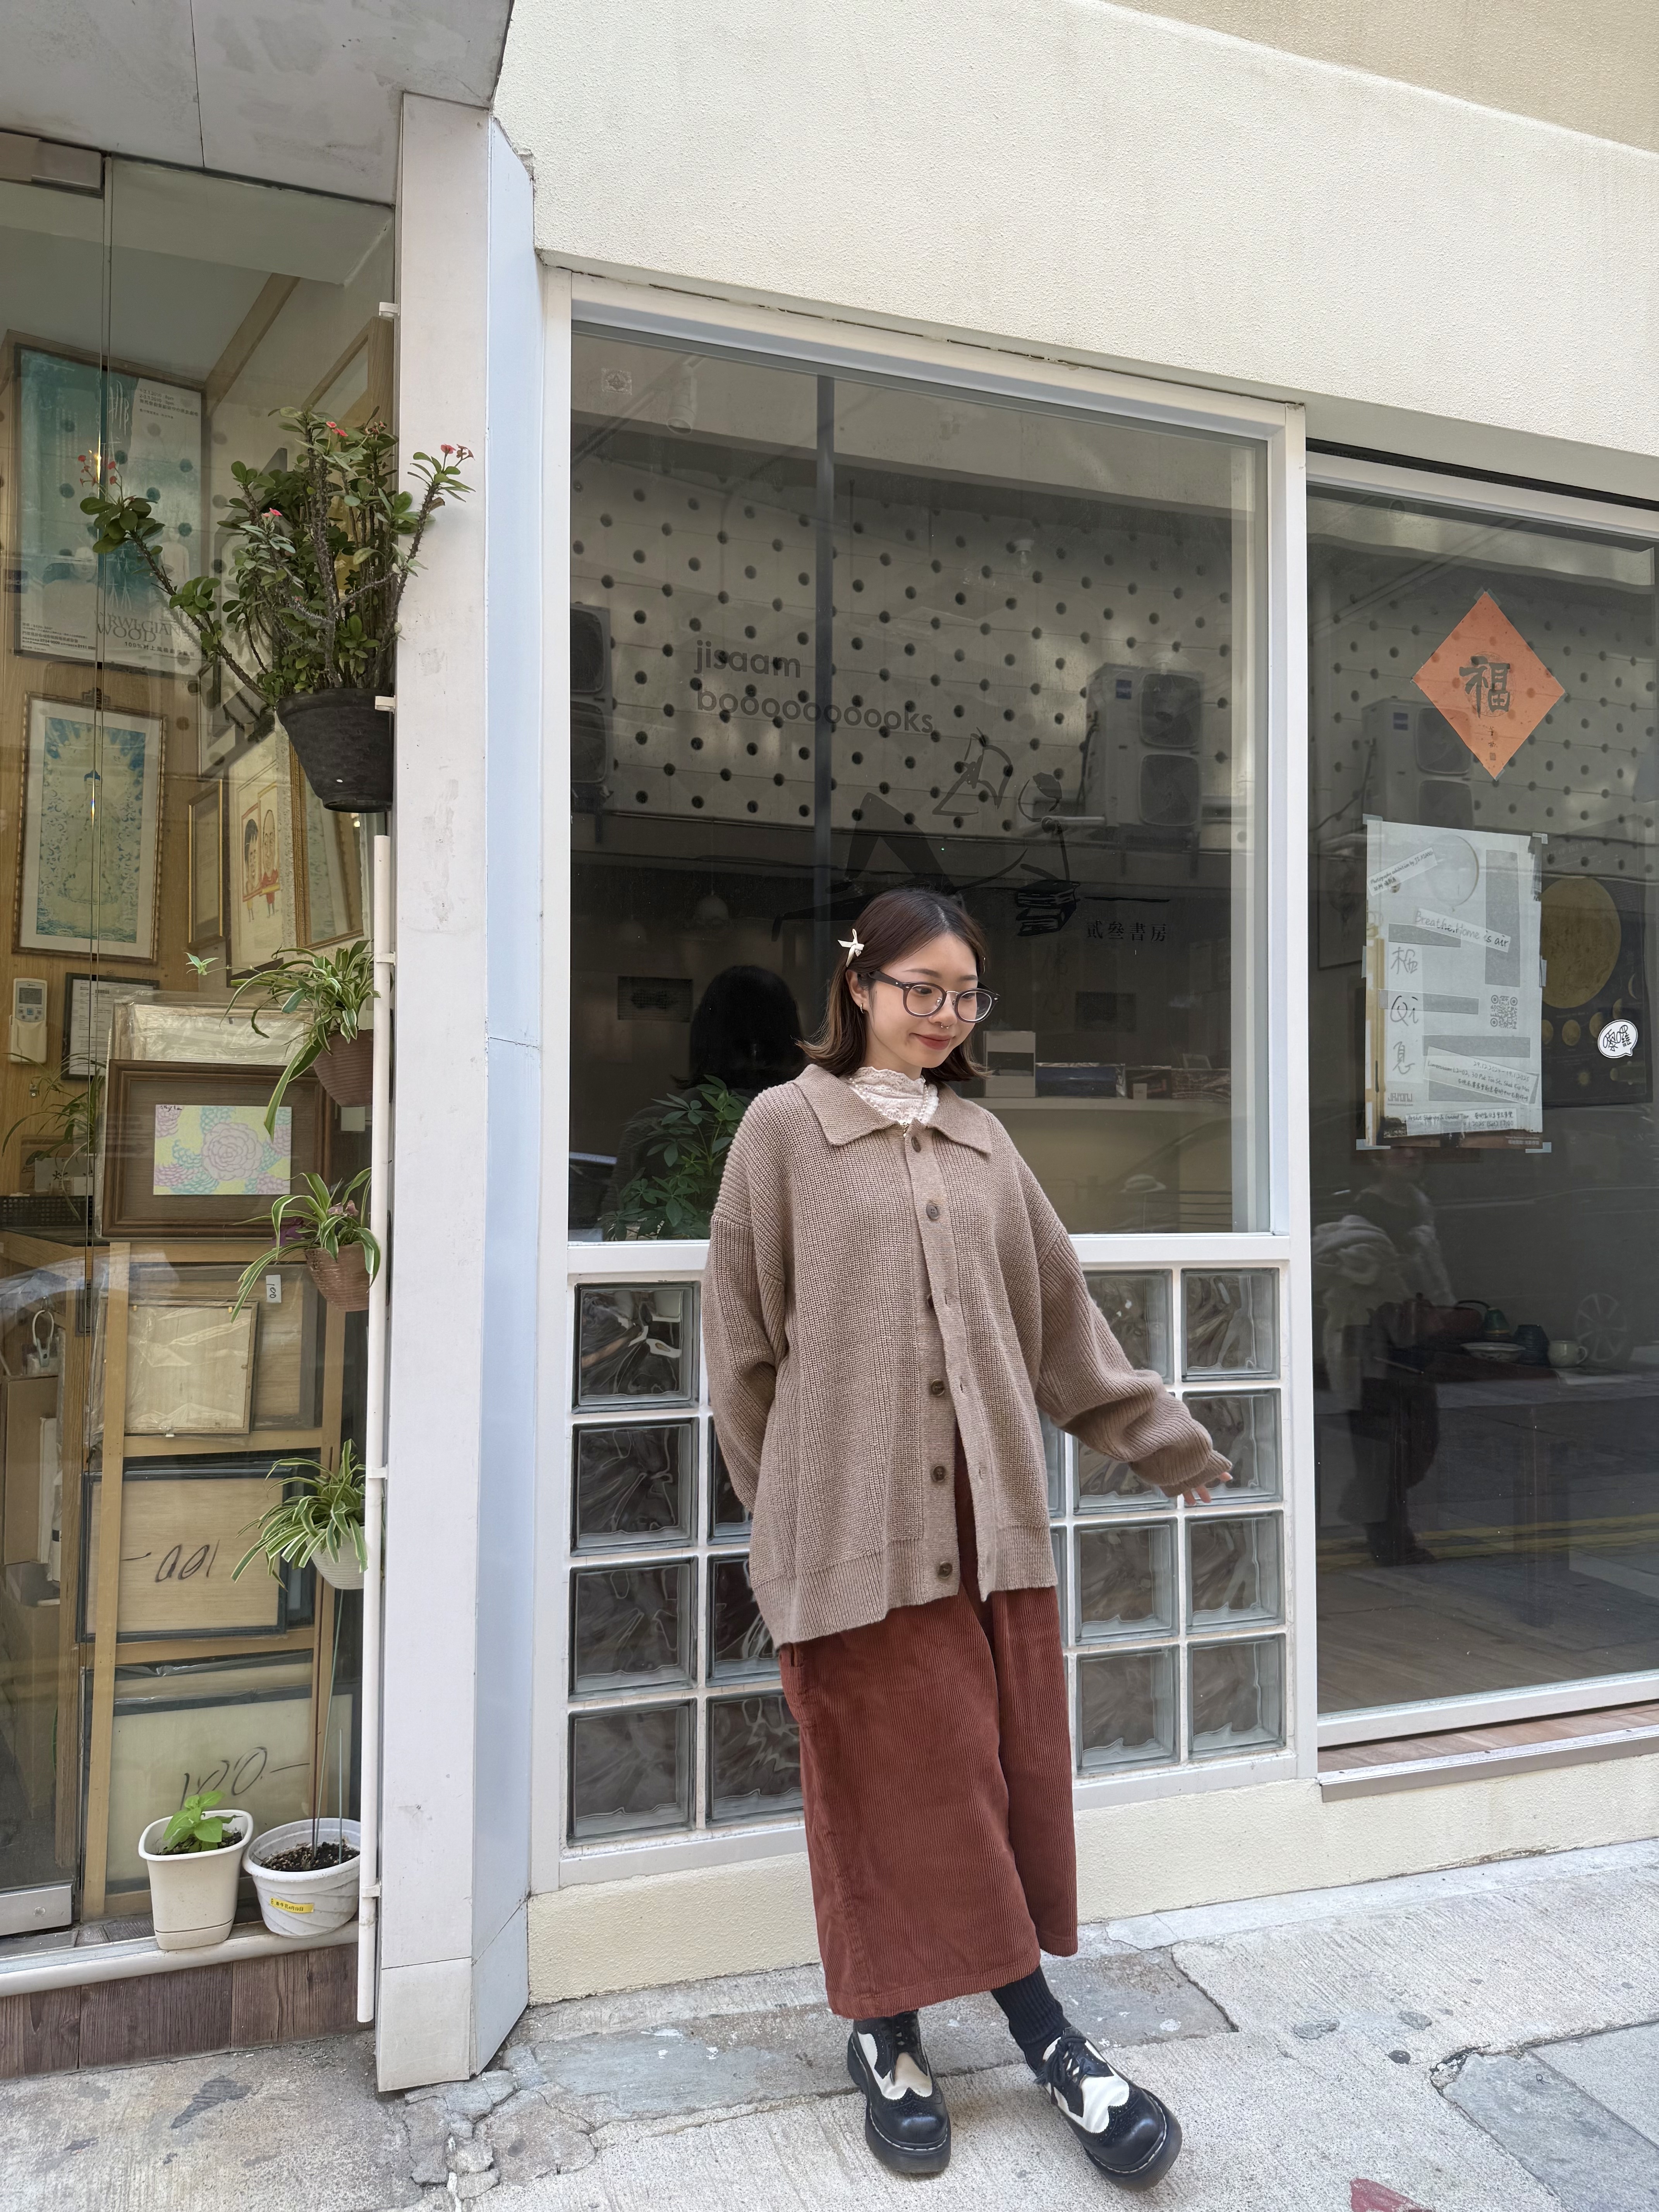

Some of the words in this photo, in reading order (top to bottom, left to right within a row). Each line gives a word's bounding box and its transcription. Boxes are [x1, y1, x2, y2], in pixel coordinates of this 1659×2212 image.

[98, 622, 156, 642] WOOD
[694, 639, 801, 678] jisaam
[1459, 656, 1510, 718] 福
[697, 682, 934, 733] boooooooooks
[1483, 930, 1492, 943] is
[1494, 934, 1509, 947] air
